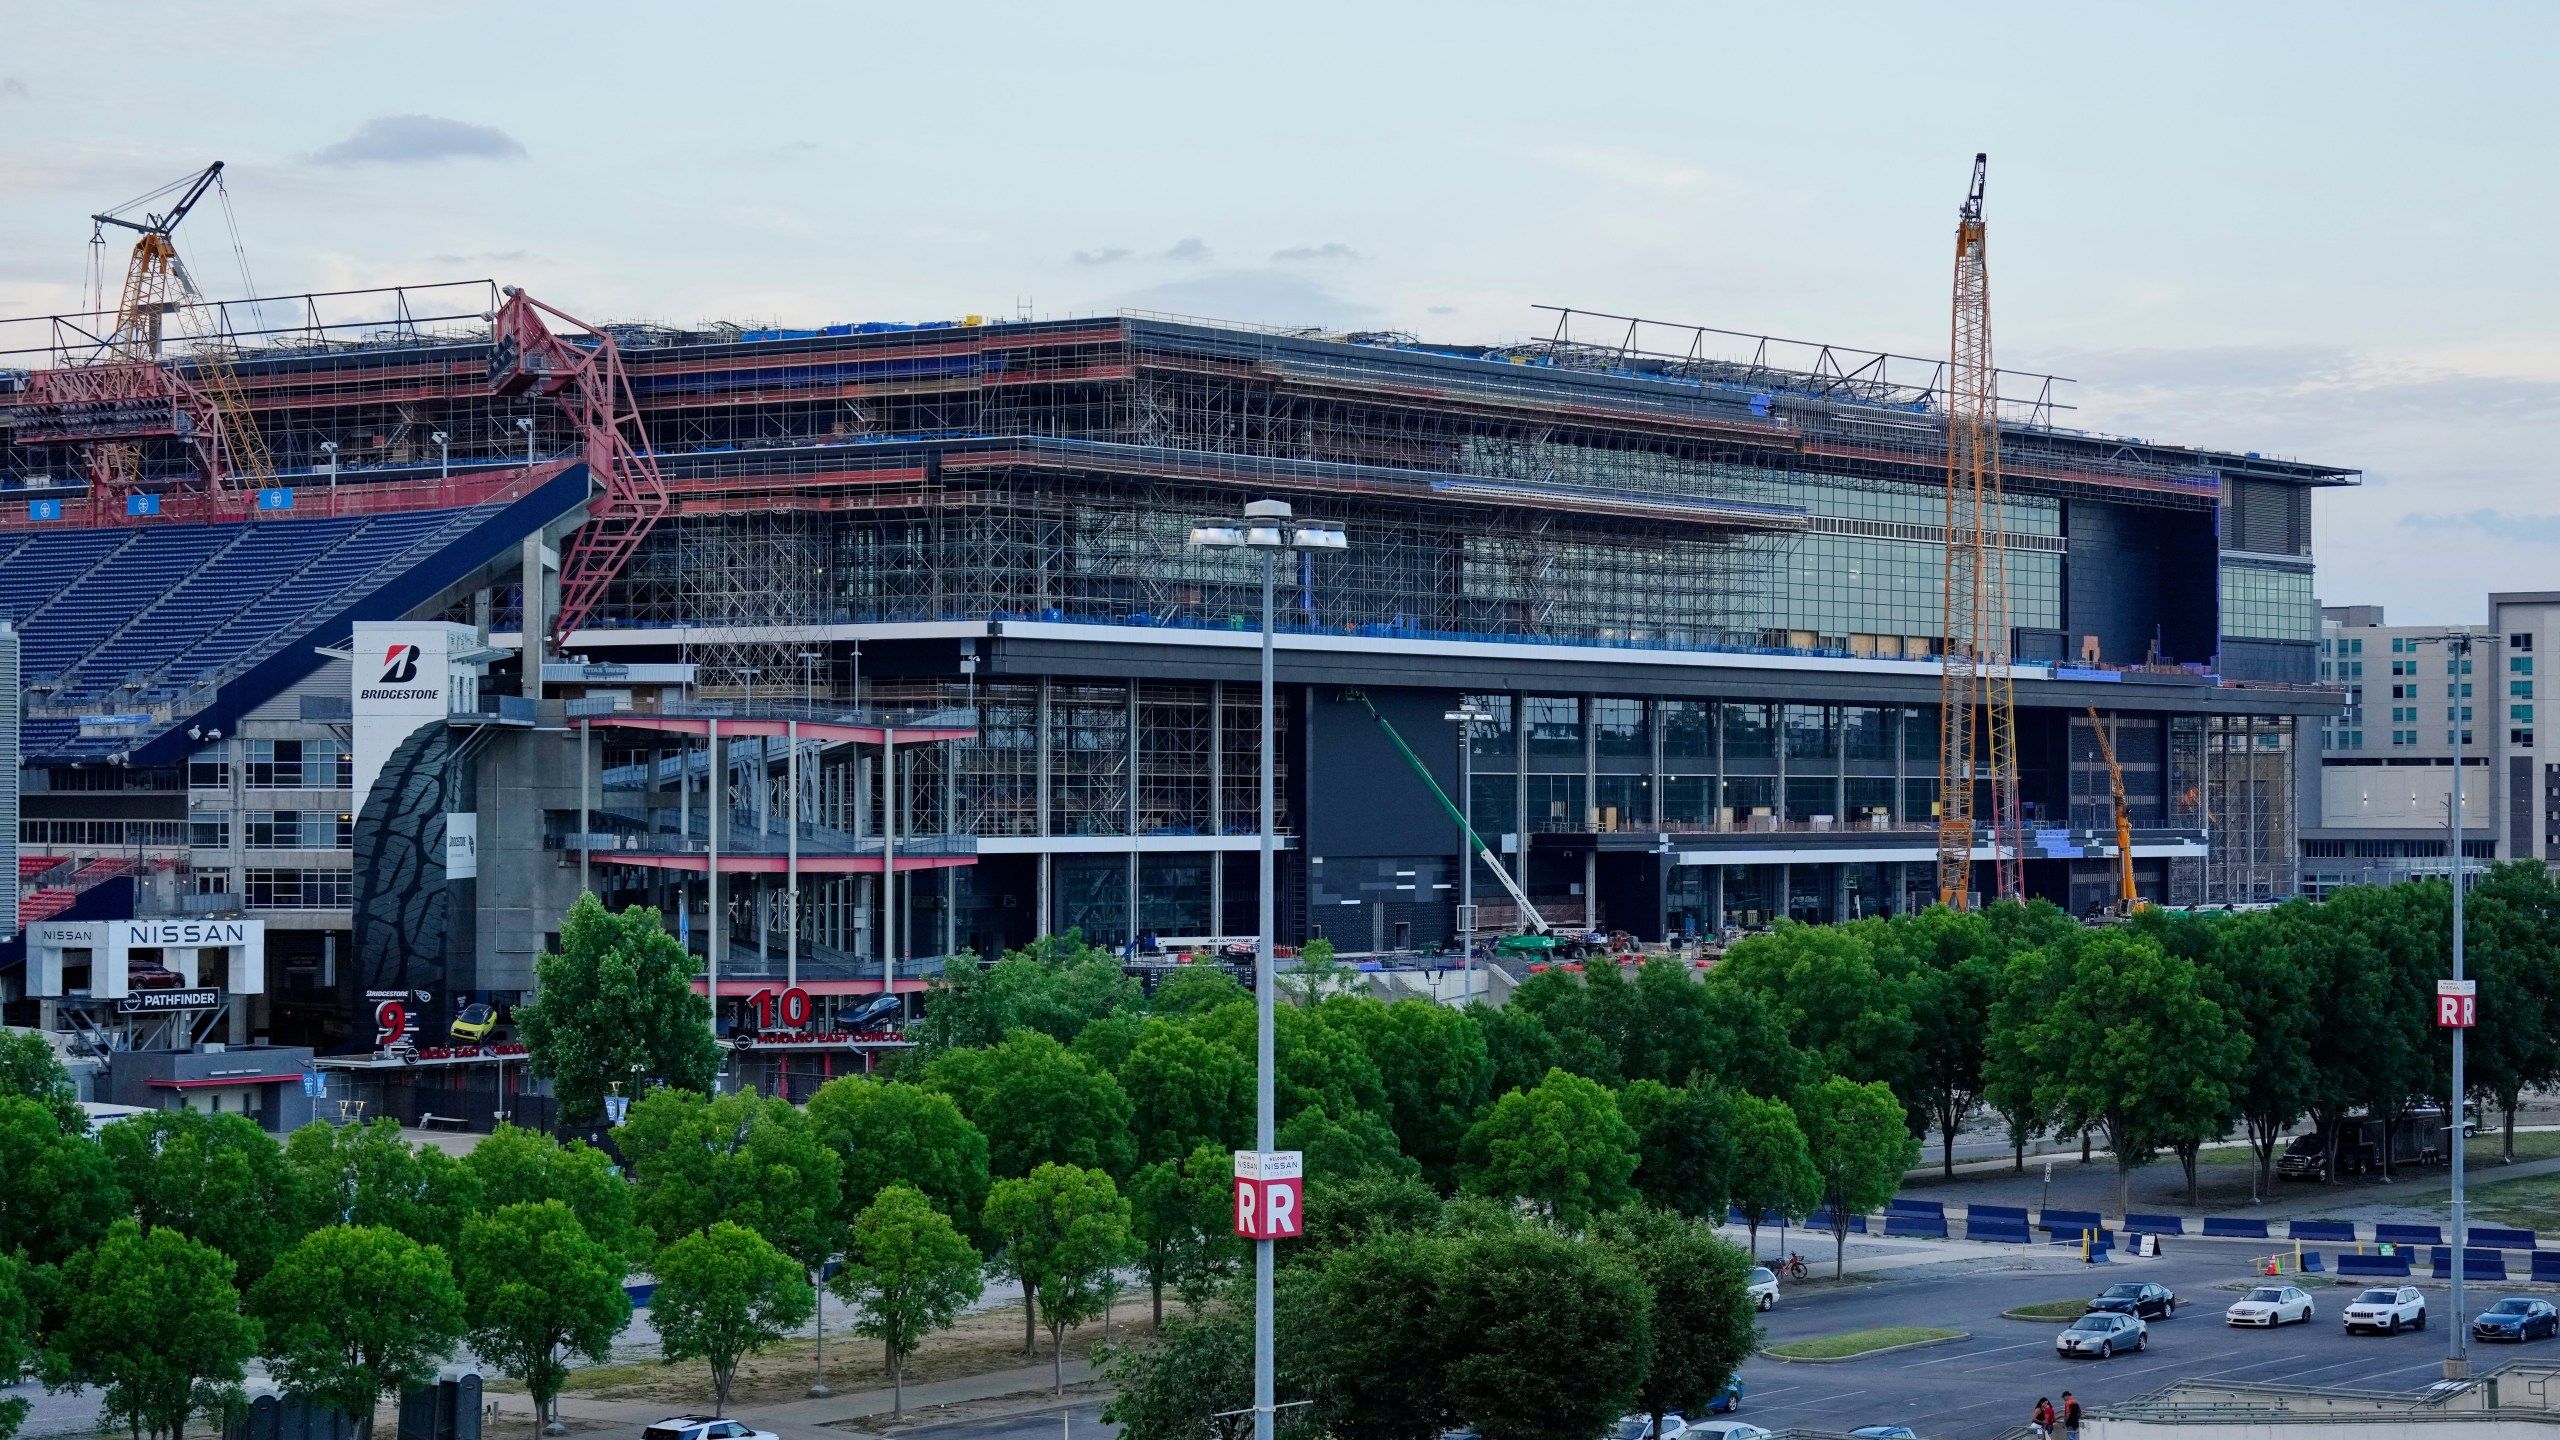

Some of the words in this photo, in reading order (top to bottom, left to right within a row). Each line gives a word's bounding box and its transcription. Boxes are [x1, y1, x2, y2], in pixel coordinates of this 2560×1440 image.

[361, 689, 439, 699] BRIDGESTONE
[43, 930, 92, 941] NISSAN
[131, 924, 244, 943] NISSAN
[144, 992, 215, 1006] PATHFINDER
[747, 987, 811, 1028] 10
[2441, 997, 2458, 1024] R
[2463, 997, 2473, 1024] R
[375, 1000, 405, 1045] 9
[817, 1031, 849, 1043] EAST
[1237, 1160, 1258, 1170] NISSAN
[1264, 1162, 1298, 1170] NISSAN
[1239, 1182, 1256, 1233] R
[1267, 1184, 1295, 1234] R
